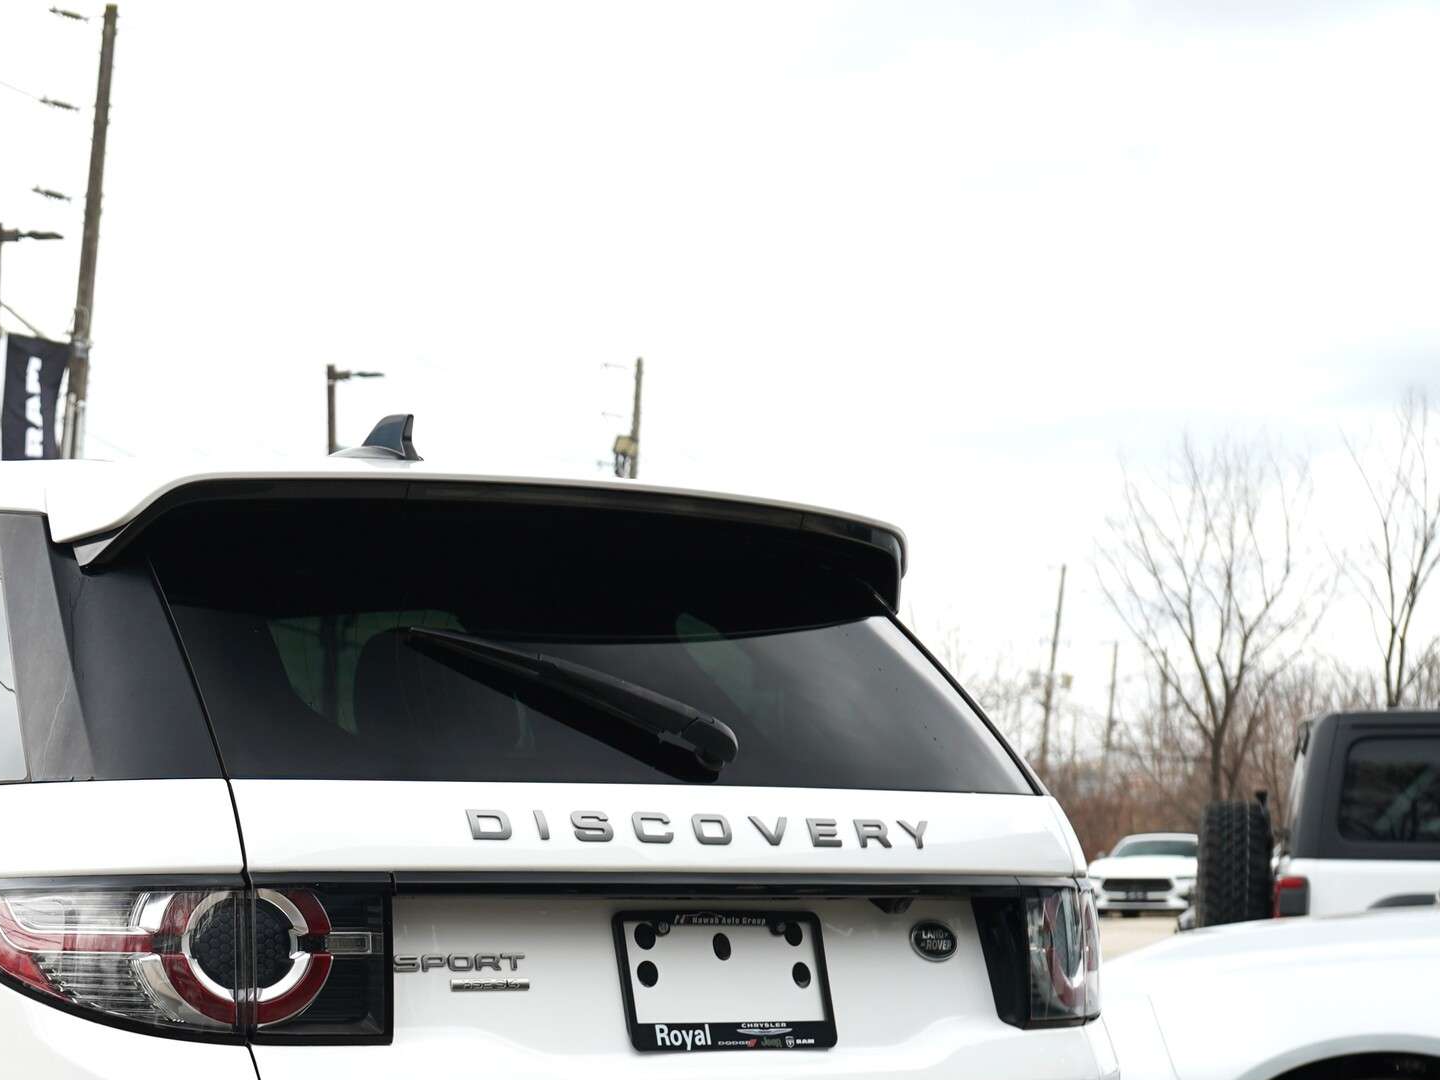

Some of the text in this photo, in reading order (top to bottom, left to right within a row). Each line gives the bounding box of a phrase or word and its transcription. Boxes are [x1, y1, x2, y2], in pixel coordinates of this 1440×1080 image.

[465, 808, 929, 850] DISCOVERY
[922, 930, 944, 939] LAND
[926, 940, 951, 950] ROVER
[393, 952, 526, 973] SPORT
[654, 1023, 711, 1050] Royal
[761, 1037, 782, 1048] Jeep
